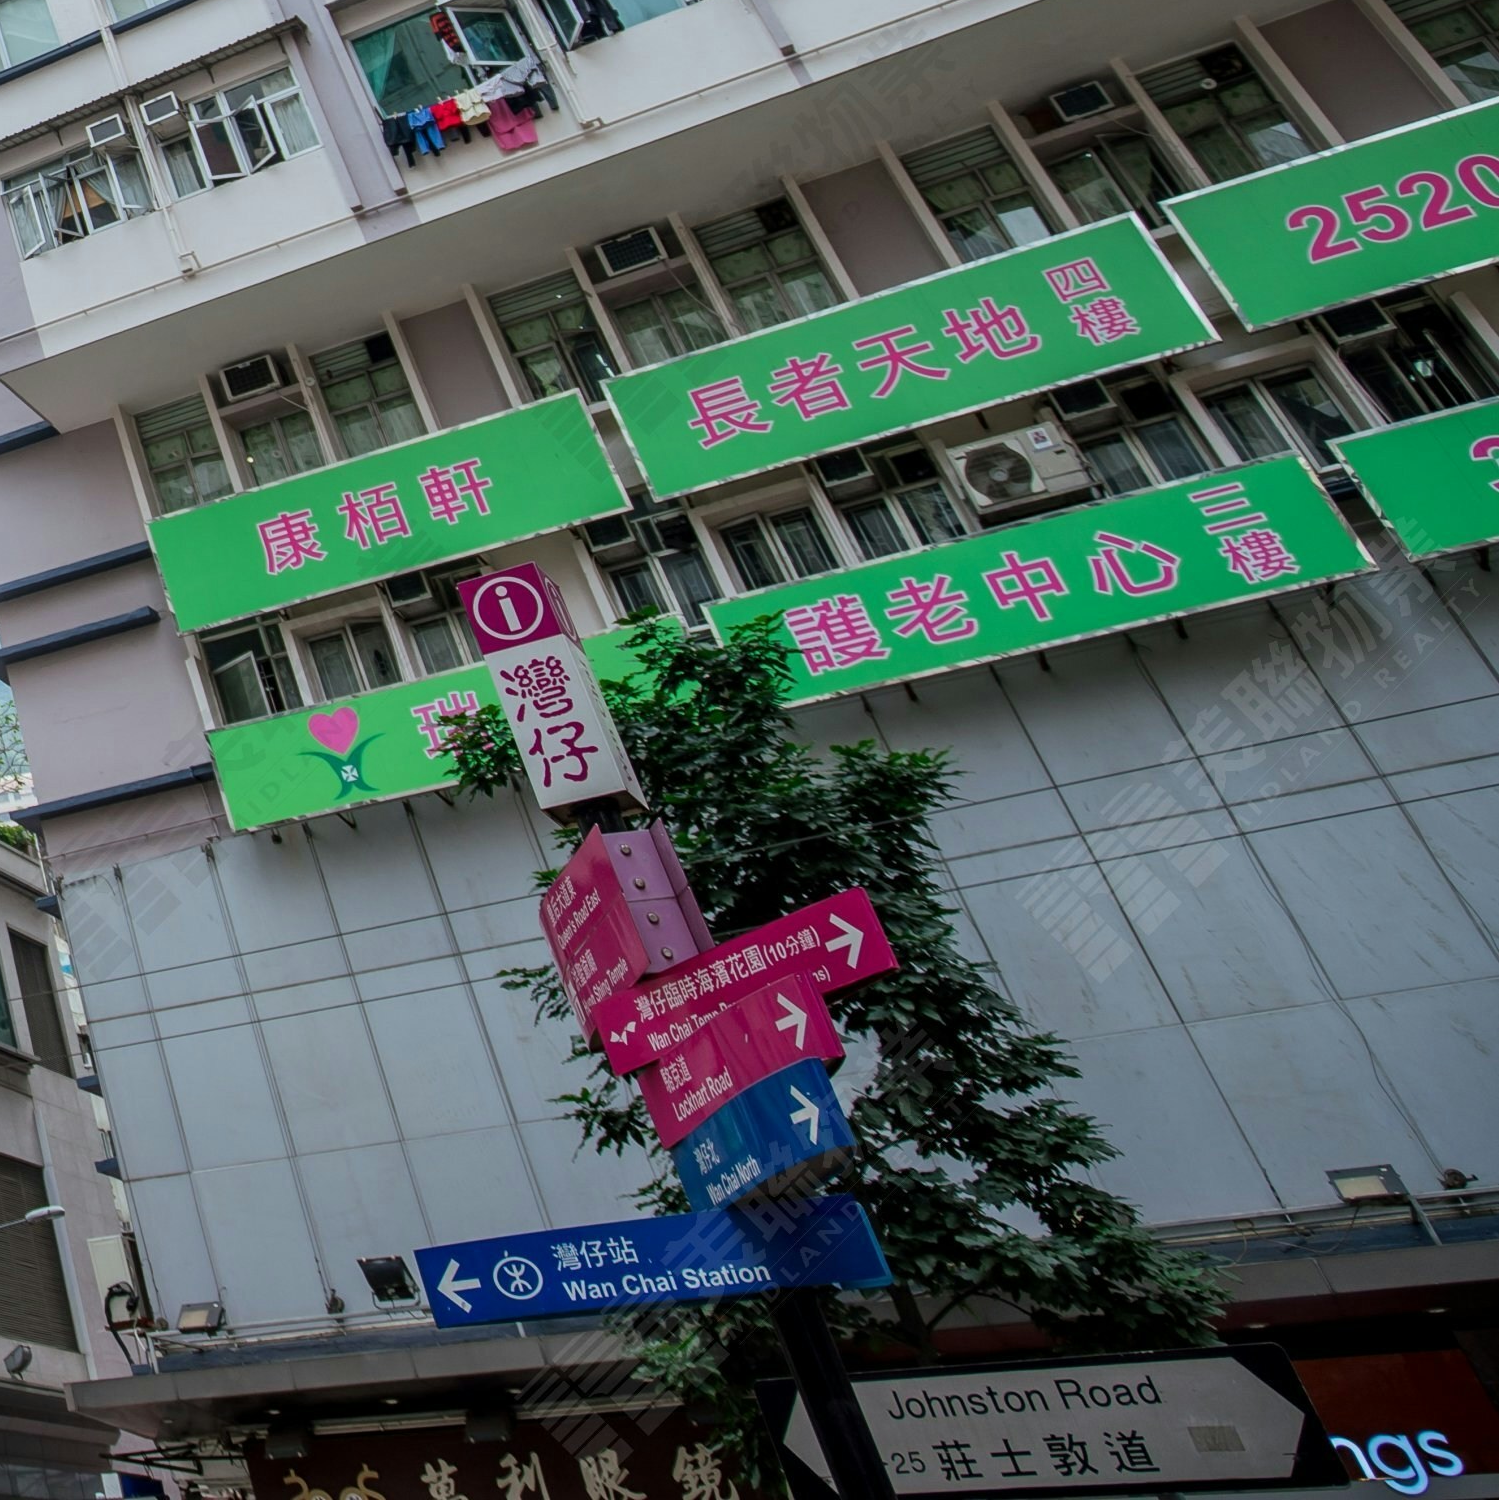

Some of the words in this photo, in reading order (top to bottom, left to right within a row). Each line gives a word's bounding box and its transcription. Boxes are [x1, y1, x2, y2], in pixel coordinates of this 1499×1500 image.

[1285, 153, 1499, 264] 2520
[1042, 257, 1140, 348] 四樓
[687, 297, 1042, 450] 長者天地
[257, 457, 493, 576] 康栢軒
[1188, 480, 1302, 584] 三樓
[785, 530, 1182, 676] 護老中心
[500, 655, 599, 788] 灣仔
[572, 900, 590, 929] Road
[585, 886, 602, 913] East
[647, 1029, 672, 1051] Wan
[669, 1019, 693, 1044] Chai
[671, 1082, 709, 1123] Lockhart
[705, 1065, 734, 1100] Road
[705, 1181, 726, 1206] Wan
[720, 1166, 740, 1196] Chai
[735, 1154, 762, 1183] North
[551, 1235, 640, 1271] 灣仔站
[561, 1273, 618, 1302] Wan
[622, 1268, 676, 1296] Chai
[684, 1261, 772, 1290] Station
[887, 1383, 1048, 1423] Johnston
[1060, 1374, 1162, 1412] Road
[932, 1429, 1160, 1483] 莊士敦道
